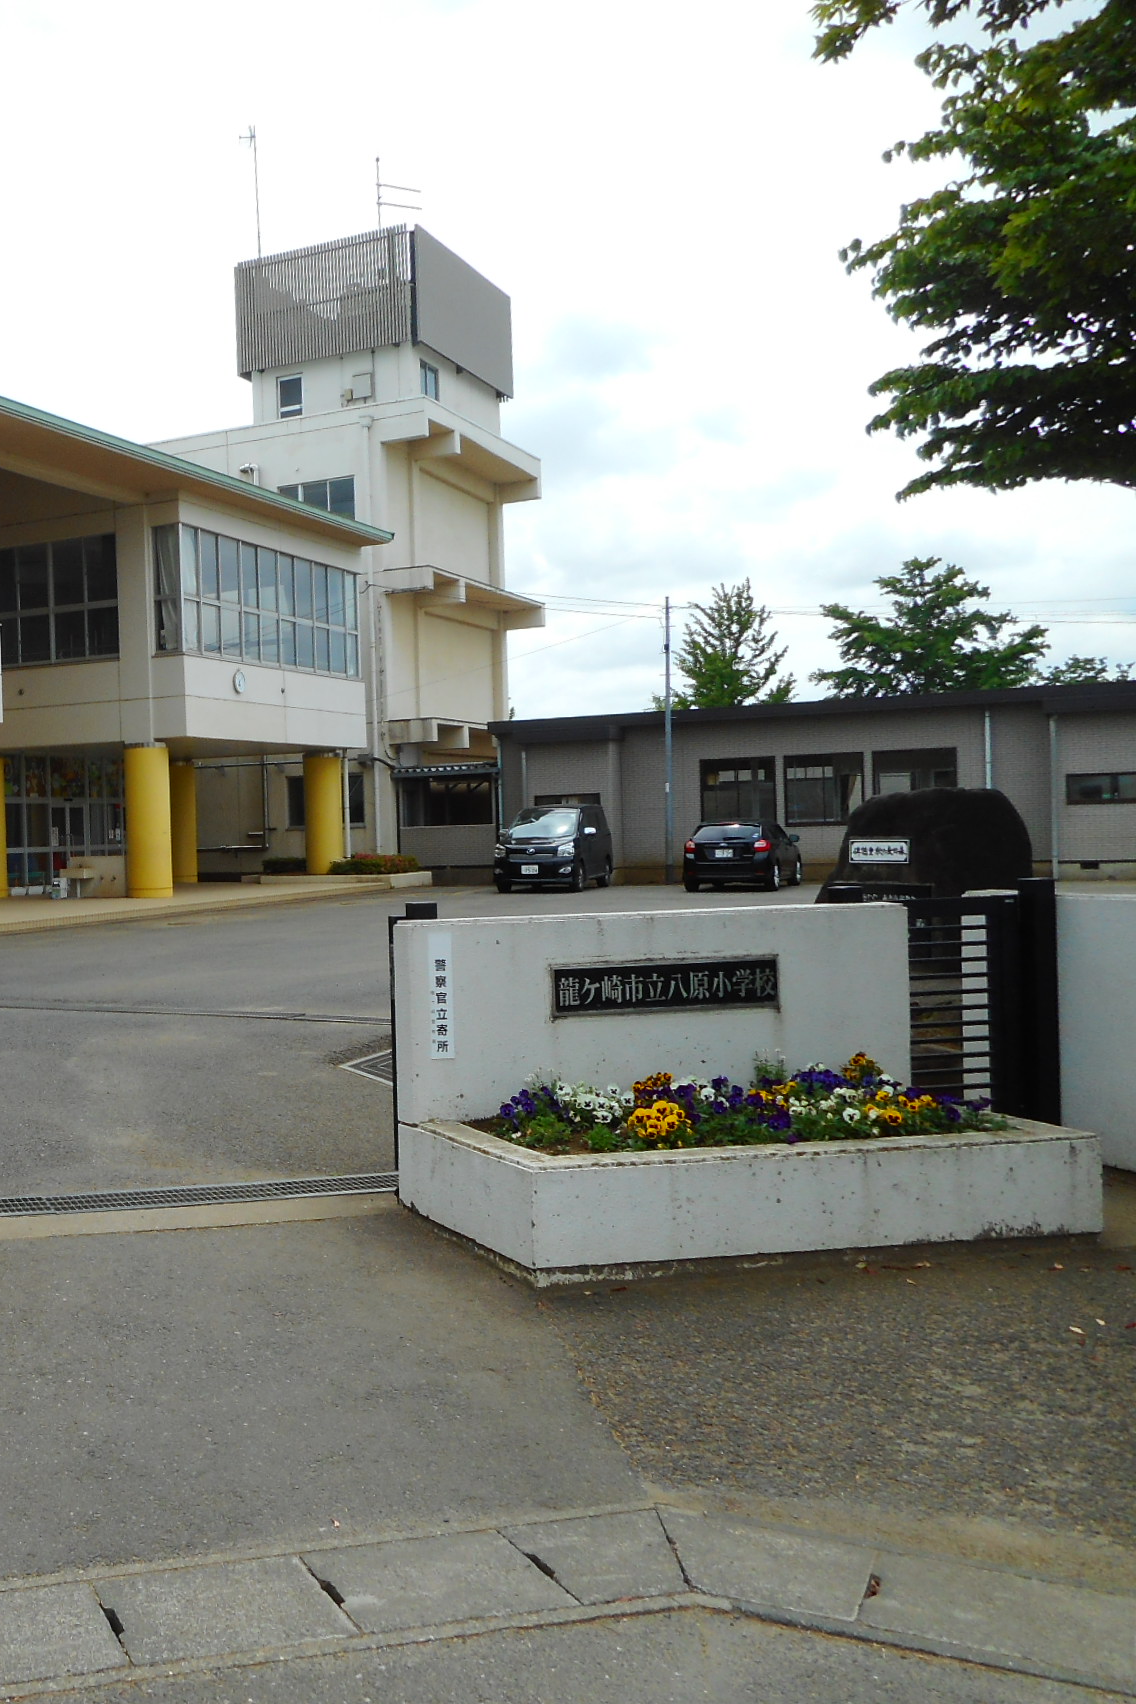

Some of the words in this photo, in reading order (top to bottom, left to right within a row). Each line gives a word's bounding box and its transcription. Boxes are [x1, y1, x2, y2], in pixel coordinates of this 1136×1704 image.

[434, 959, 449, 1053] 警察官立寄所
